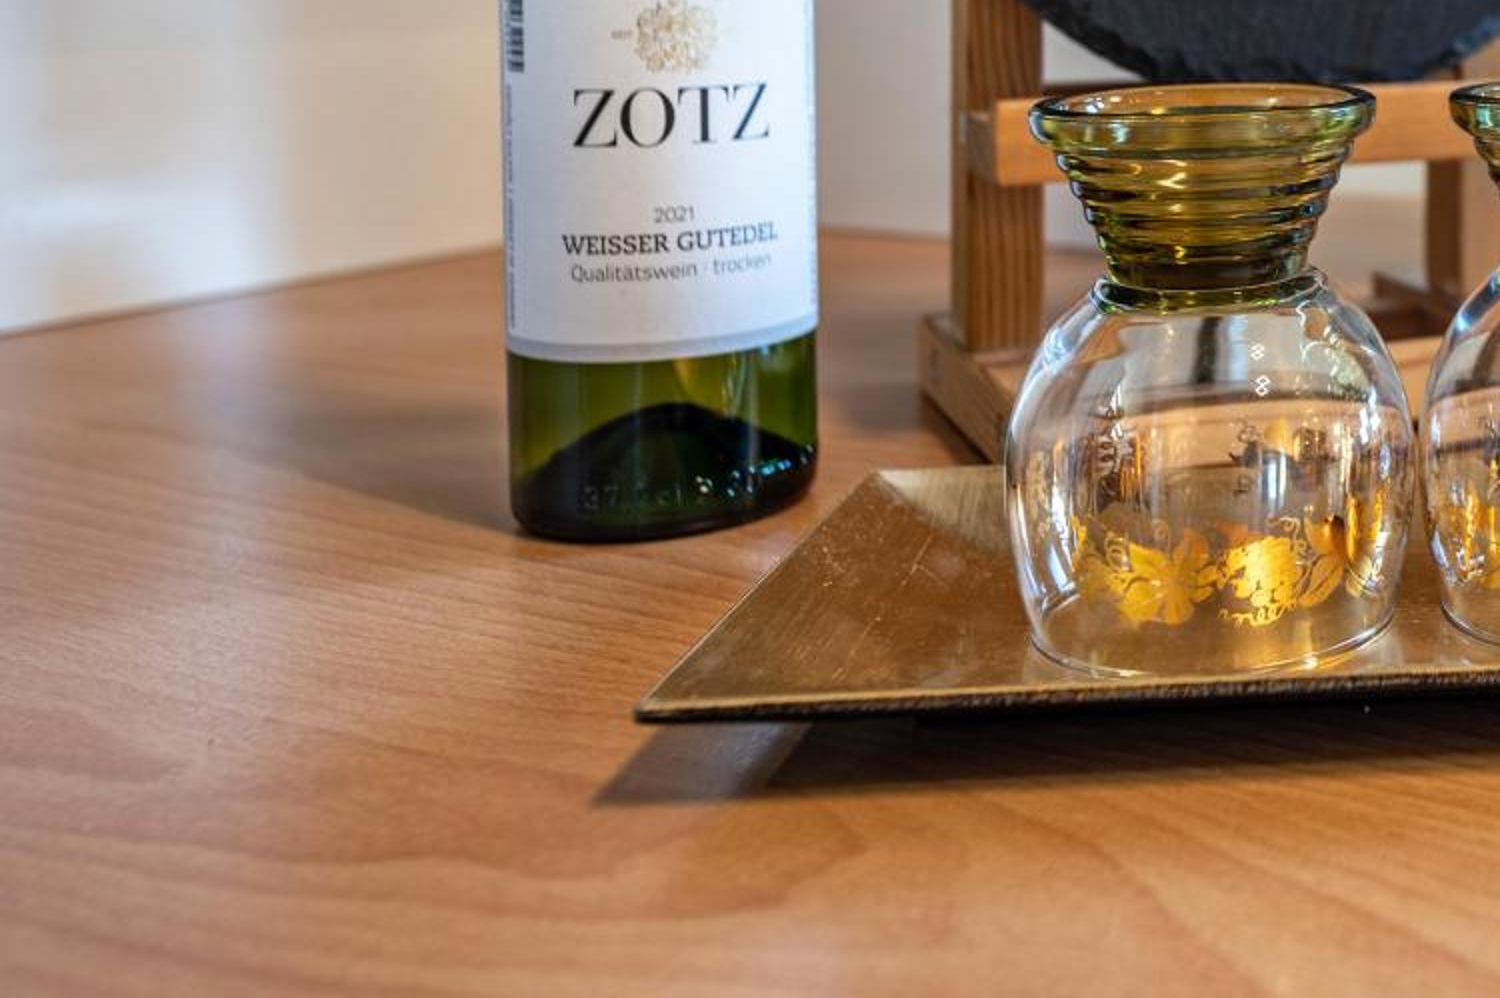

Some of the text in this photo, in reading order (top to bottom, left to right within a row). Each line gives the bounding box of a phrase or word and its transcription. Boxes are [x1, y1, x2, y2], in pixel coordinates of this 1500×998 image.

[573, 83, 770, 149] ZOTZ
[653, 205, 695, 223] 2021
[562, 221, 778, 255] WEISSER GUTEDEL
[571, 261, 698, 283] Qualitätswein
